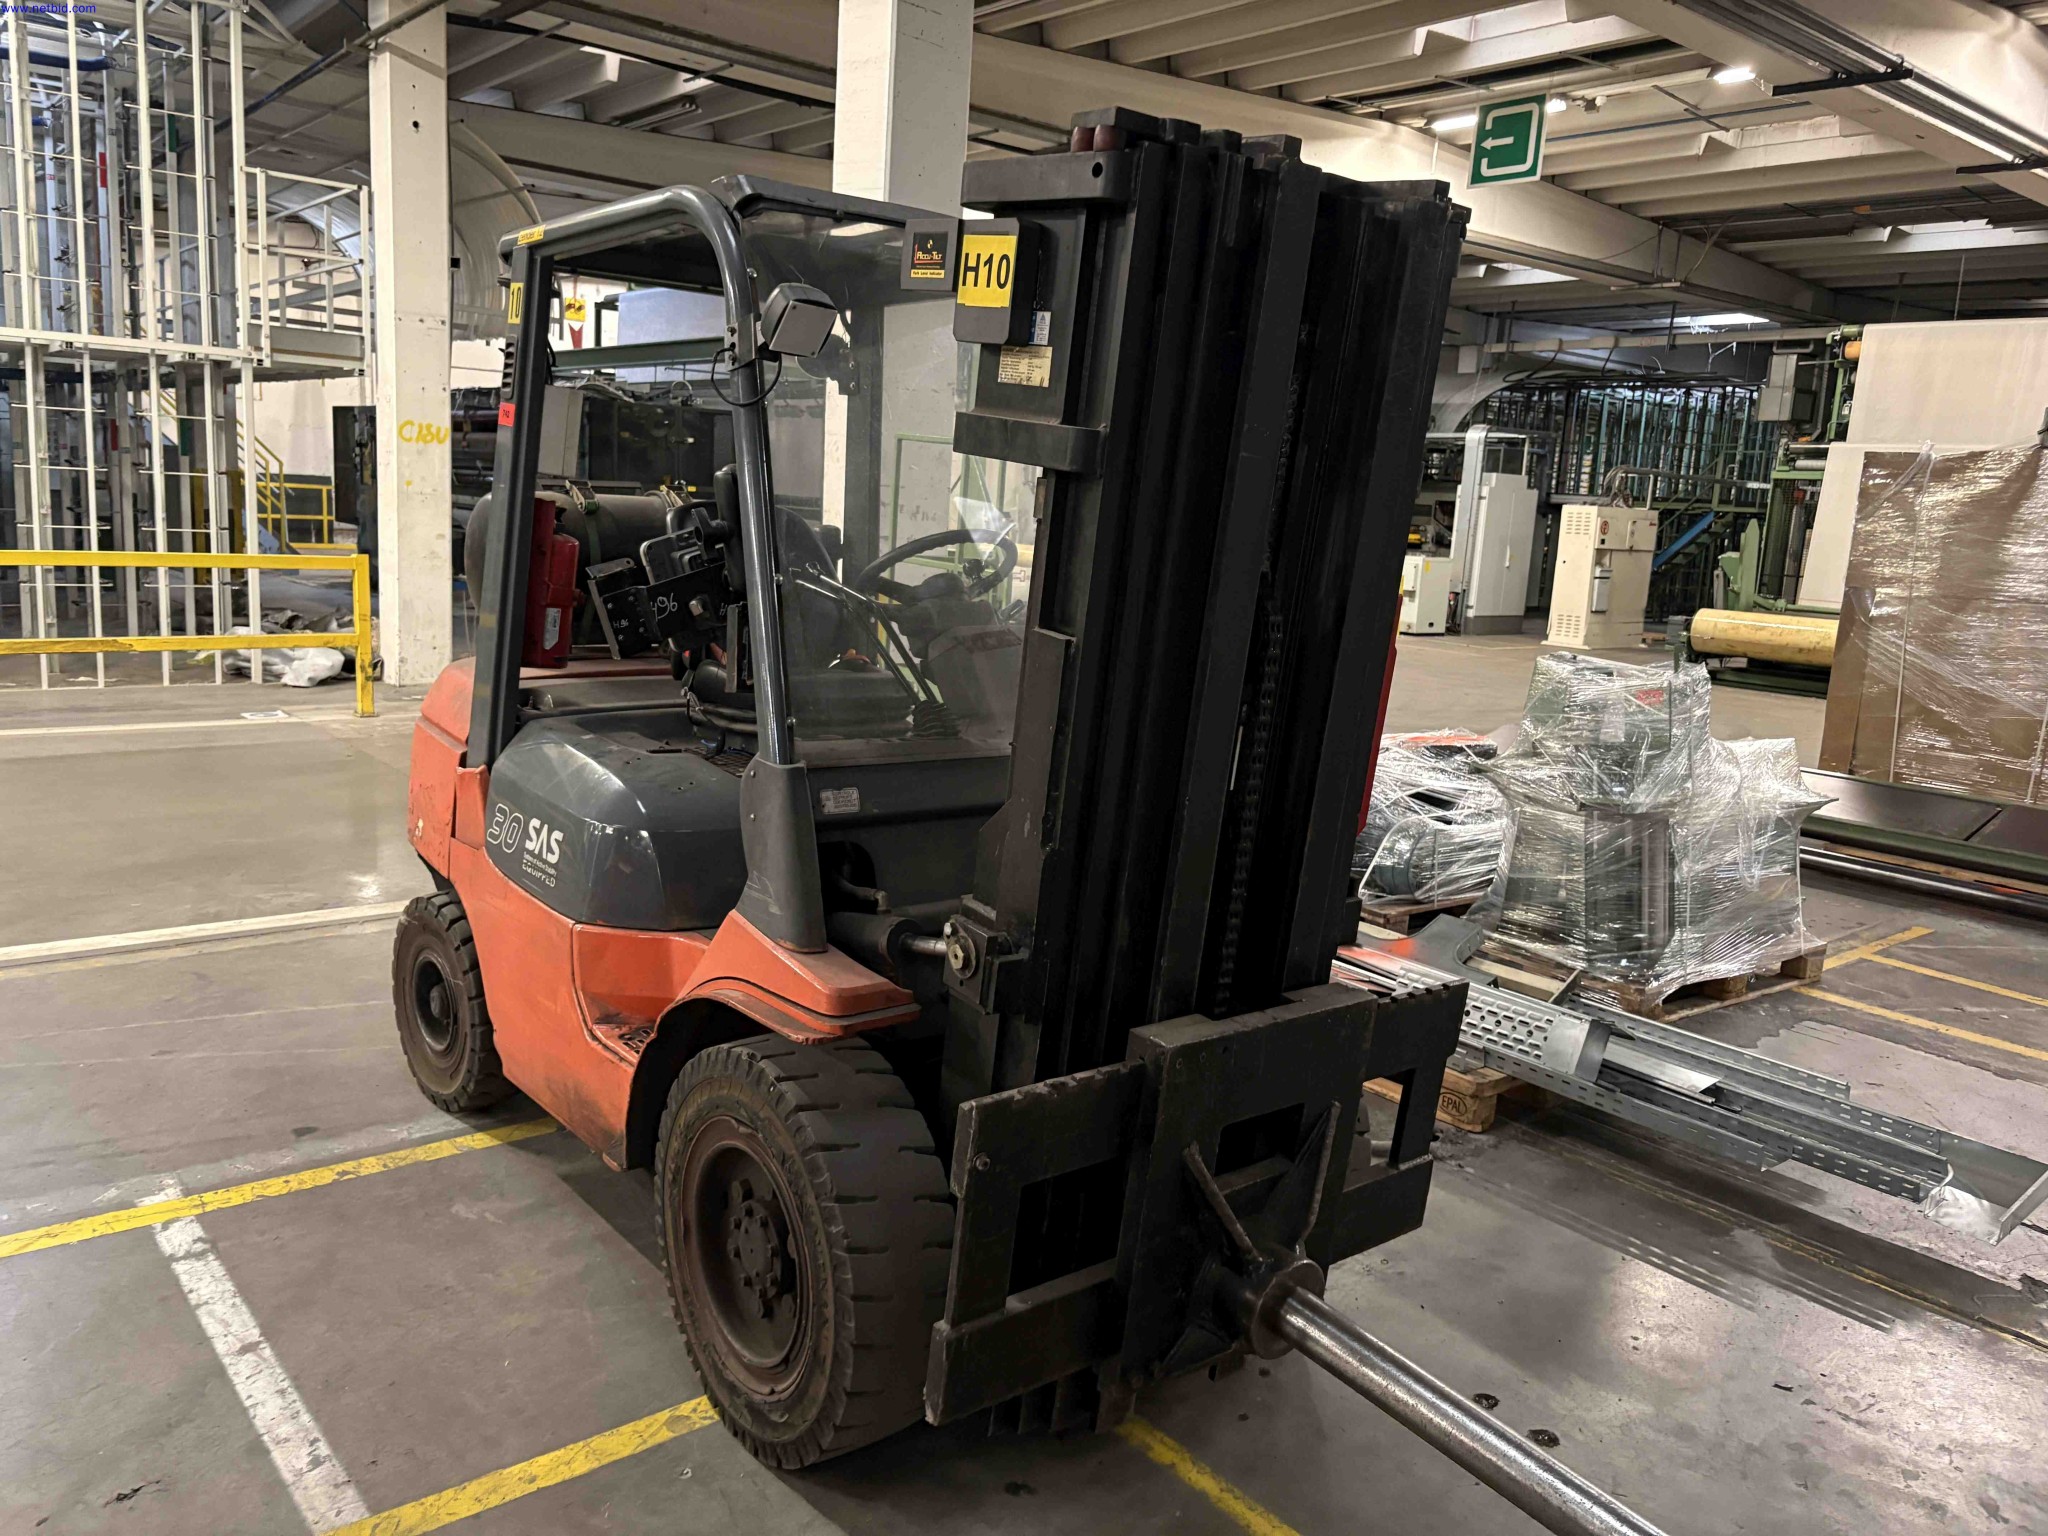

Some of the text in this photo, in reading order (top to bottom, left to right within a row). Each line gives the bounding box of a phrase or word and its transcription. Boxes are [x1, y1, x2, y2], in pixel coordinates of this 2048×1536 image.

[962, 252, 1010, 289] H10
[487, 803, 523, 853] 30
[525, 818, 564, 864] SAS
[1441, 1095, 1462, 1114] EPAL
